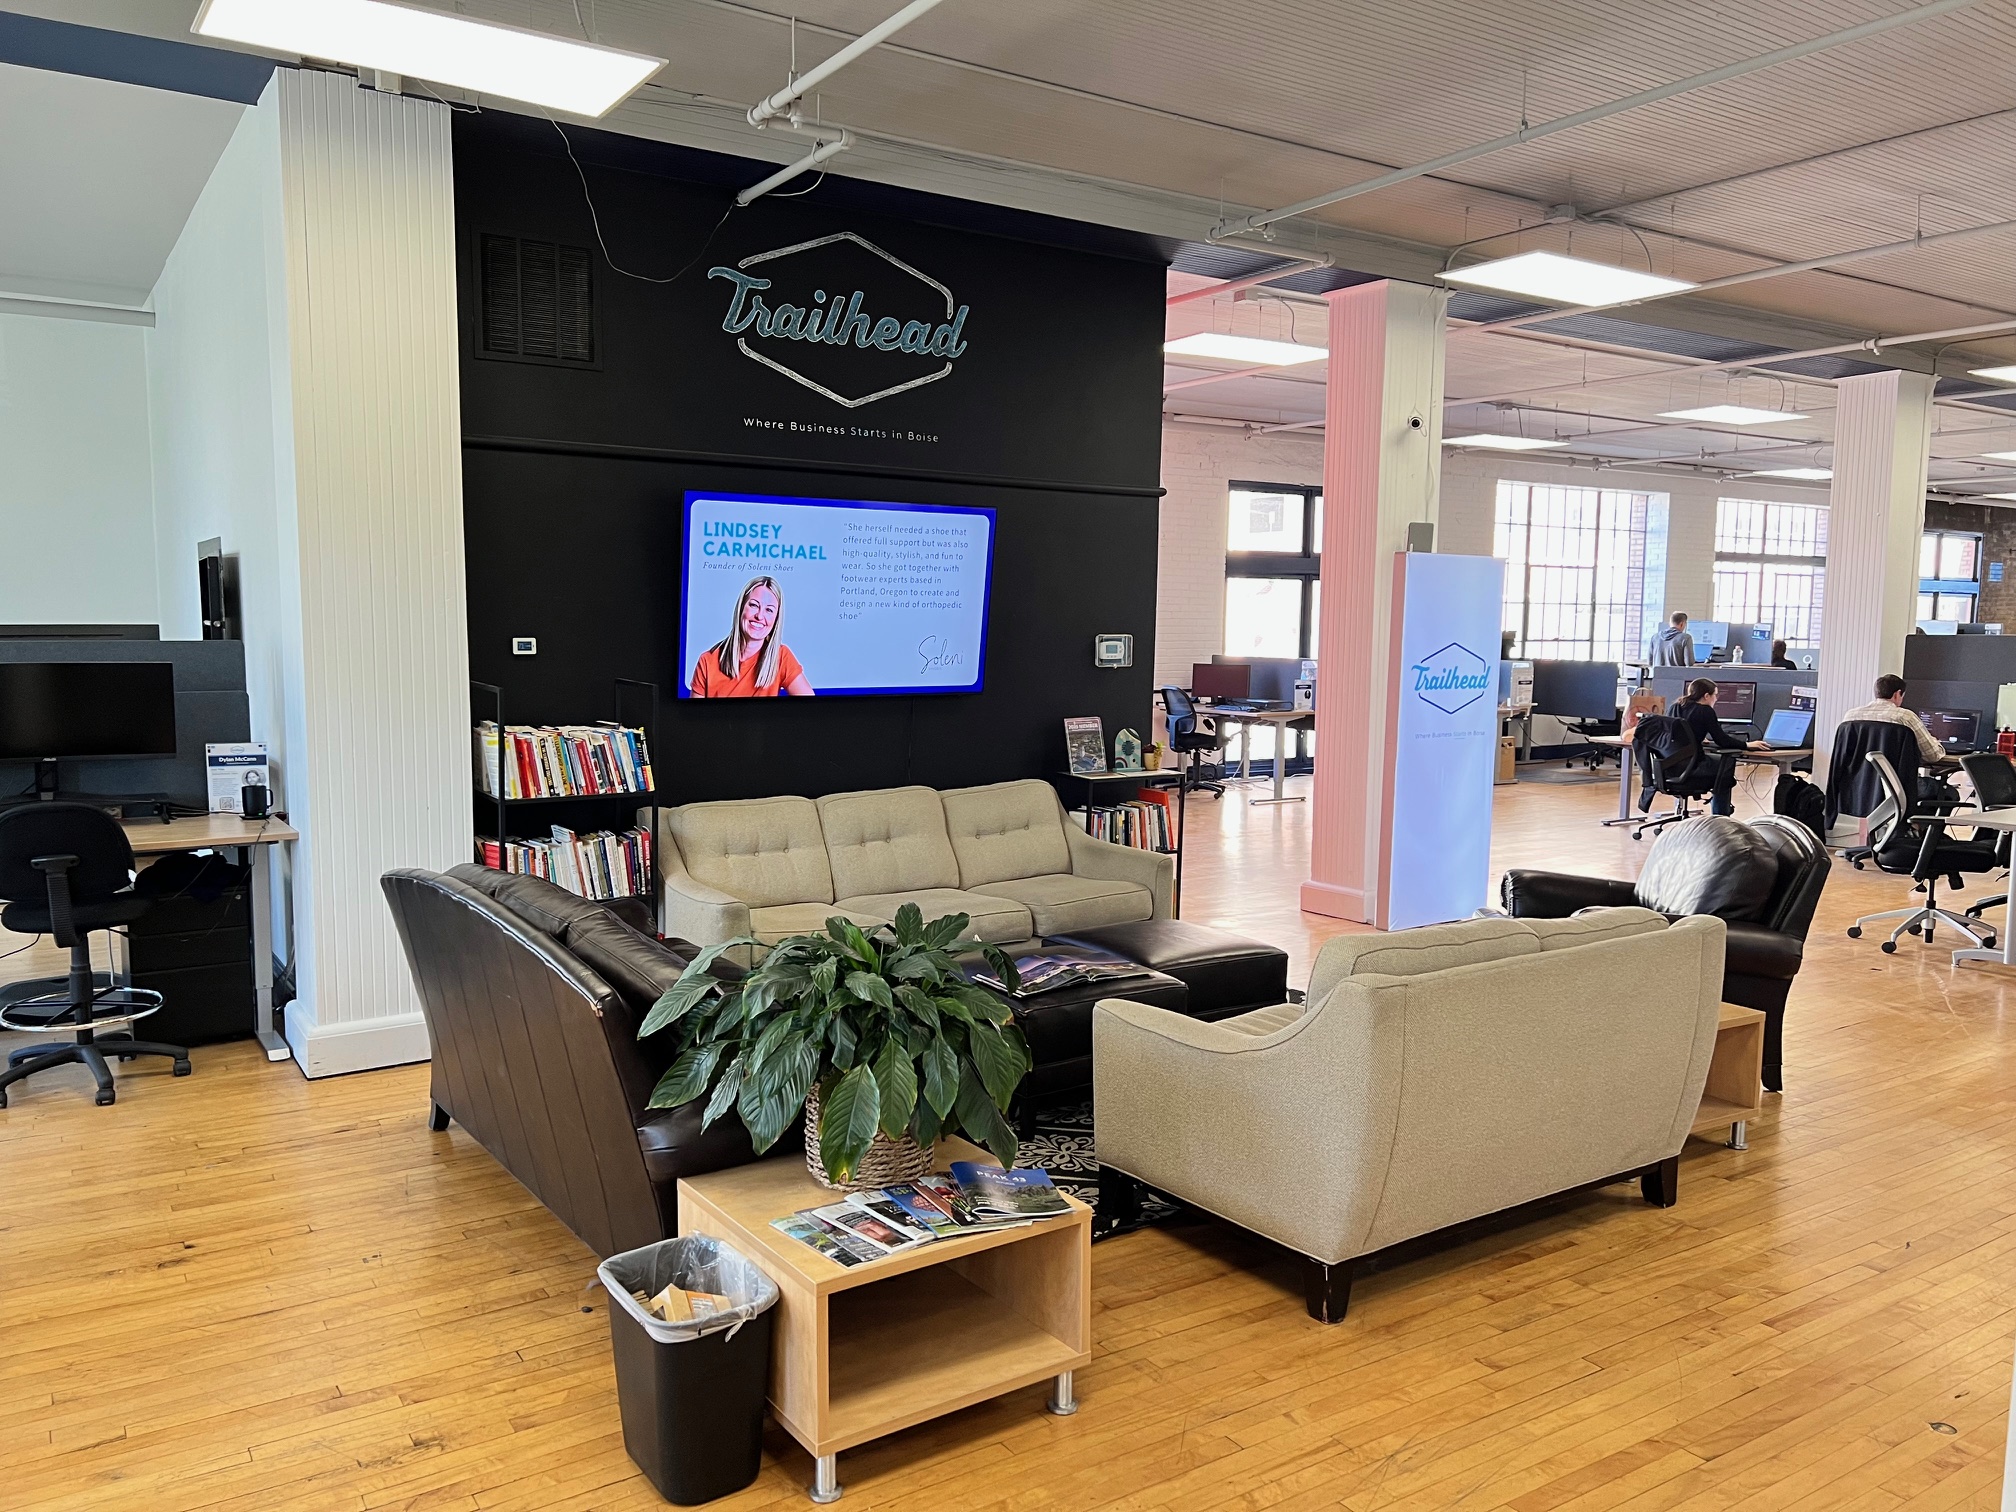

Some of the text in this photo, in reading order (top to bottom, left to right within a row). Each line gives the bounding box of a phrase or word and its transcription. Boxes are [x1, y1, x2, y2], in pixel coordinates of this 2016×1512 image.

[708, 267, 969, 358] Trailhead
[744, 418, 939, 442] Where Business Starts in Boise
[704, 522, 782, 539] LINDSEY
[865, 524, 892, 533] herself
[895, 525, 923, 534] needed
[932, 527, 950, 535] shoe
[843, 536, 872, 544] offered
[874, 537, 887, 545] full
[890, 539, 920, 548] support
[922, 539, 934, 547] but
[953, 540, 968, 548] also
[703, 541, 827, 560] CARMICHAEL
[842, 549, 894, 559] high-quality,
[895, 550, 923, 560] stylish,
[925, 551, 939, 560] and
[941, 552, 953, 560] fun
[703, 562, 735, 570] Founder
[738, 563, 747, 571] of
[866, 562, 876, 570] So
[894, 564, 906, 572] got
[909, 564, 941, 573] together
[841, 574, 877, 583] footwear
[910, 576, 932, 584] based
[840, 587, 877, 596] Portland,
[880, 588, 908, 597] Oregon
[946, 589, 960, 597] and
[840, 600, 866, 609] design
[912, 600, 920, 608] of
[922, 600, 962, 609] orthopedic
[918, 635, 964, 674] Soleni
[1411, 664, 1491, 691] Trailhead
[976, 1170, 1009, 1181] PEAK
